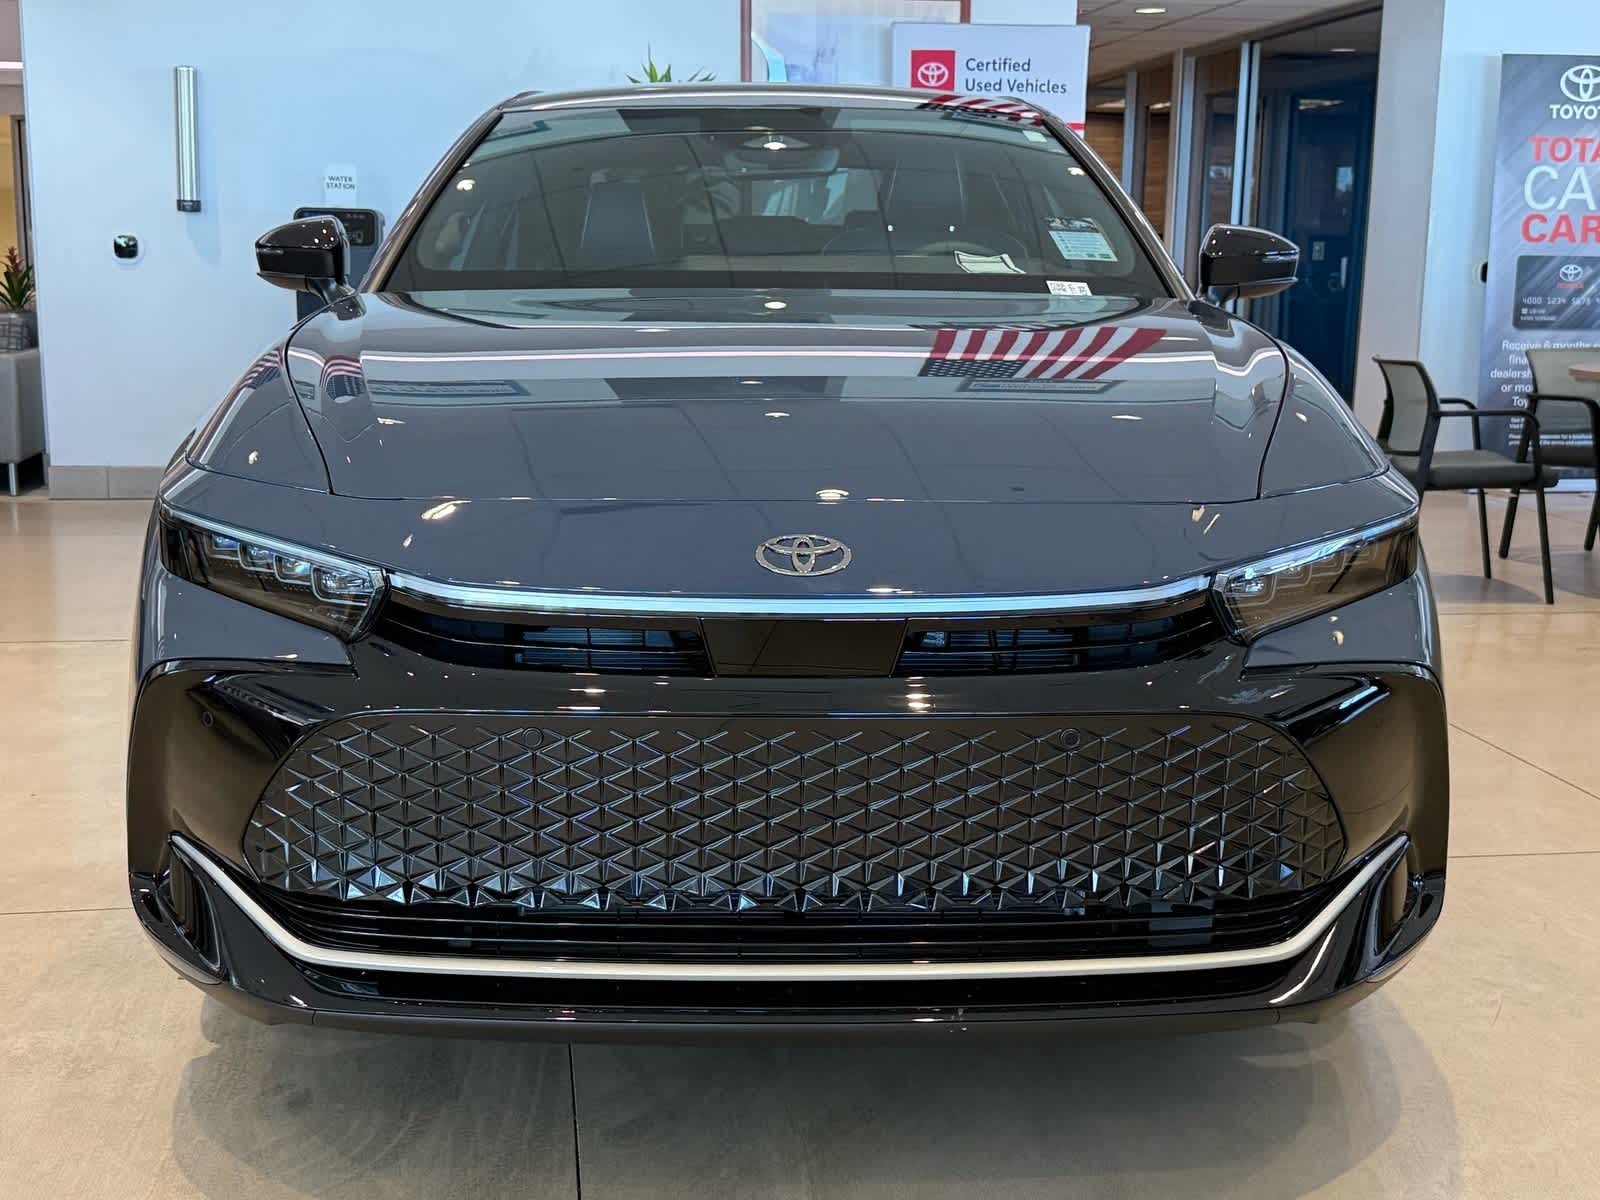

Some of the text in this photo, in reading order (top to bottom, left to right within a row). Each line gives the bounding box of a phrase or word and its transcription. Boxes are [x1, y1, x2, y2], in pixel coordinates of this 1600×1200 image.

[965, 57, 1032, 72] Certified
[965, 78, 1067, 94] Used Vehicles
[326, 182, 356, 190] STATION
[1502, 340, 1542, 351] Receive
[1501, 384, 1512, 393] or
